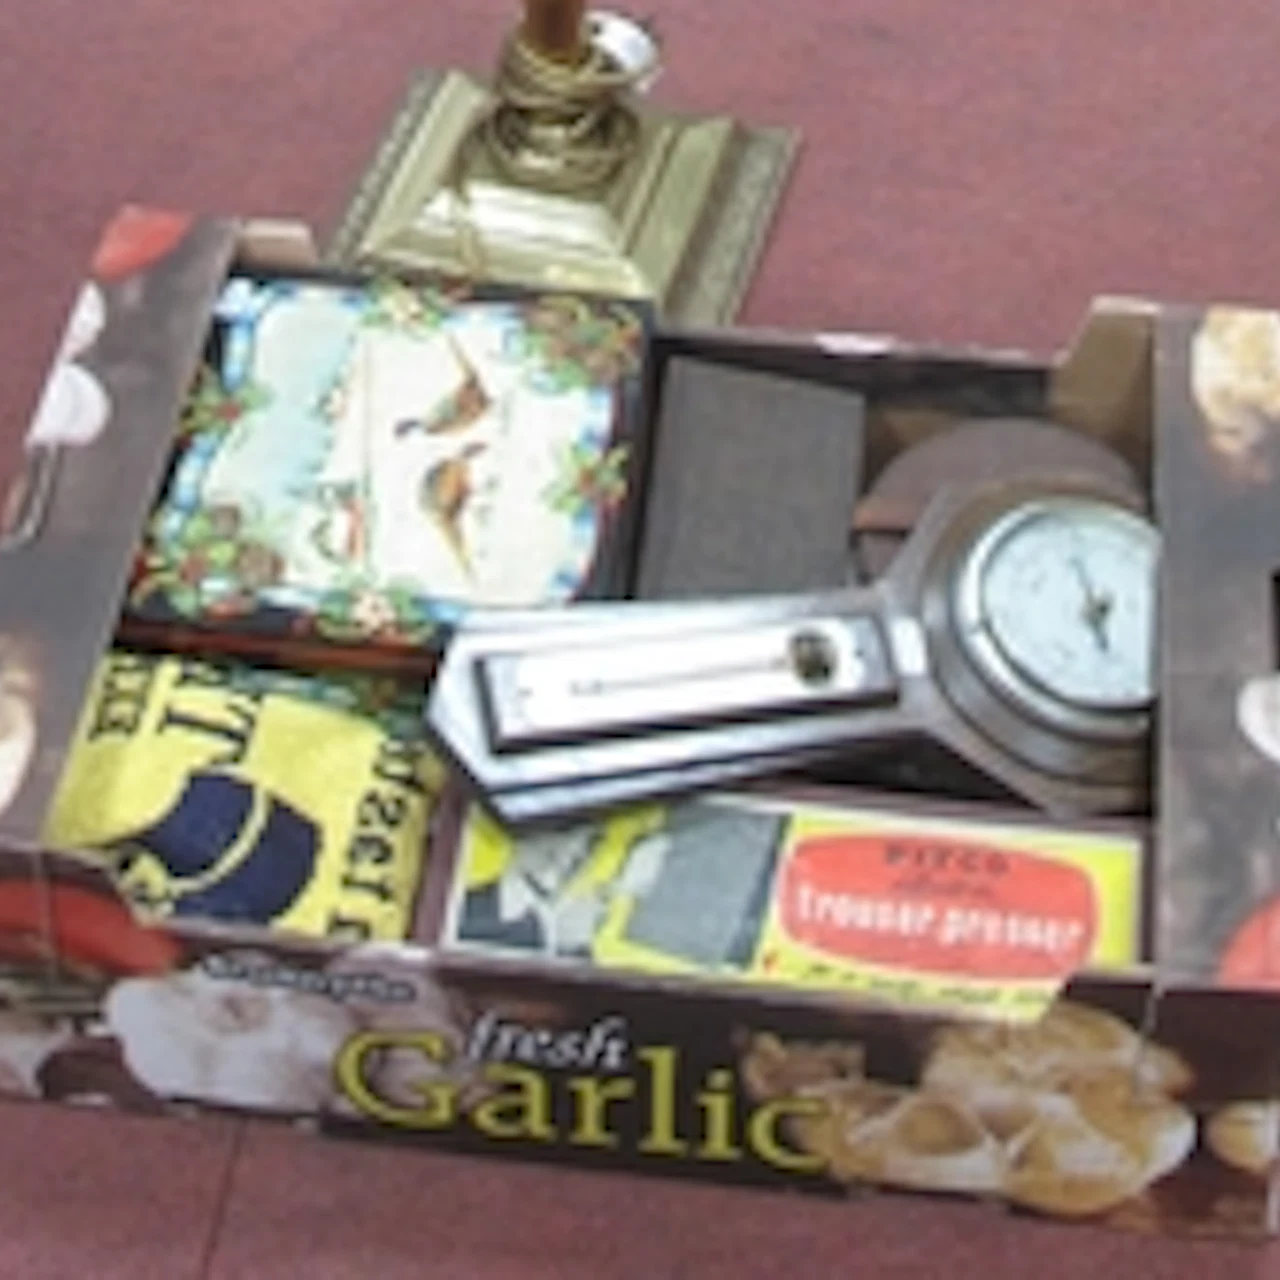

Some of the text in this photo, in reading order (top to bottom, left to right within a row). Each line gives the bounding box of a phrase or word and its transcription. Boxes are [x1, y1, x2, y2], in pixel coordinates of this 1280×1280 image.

[795, 884, 936, 936] trouser
[939, 902, 1086, 954] presser
[466, 1012, 629, 1070] fresh
[332, 1028, 830, 1172] Garlic
